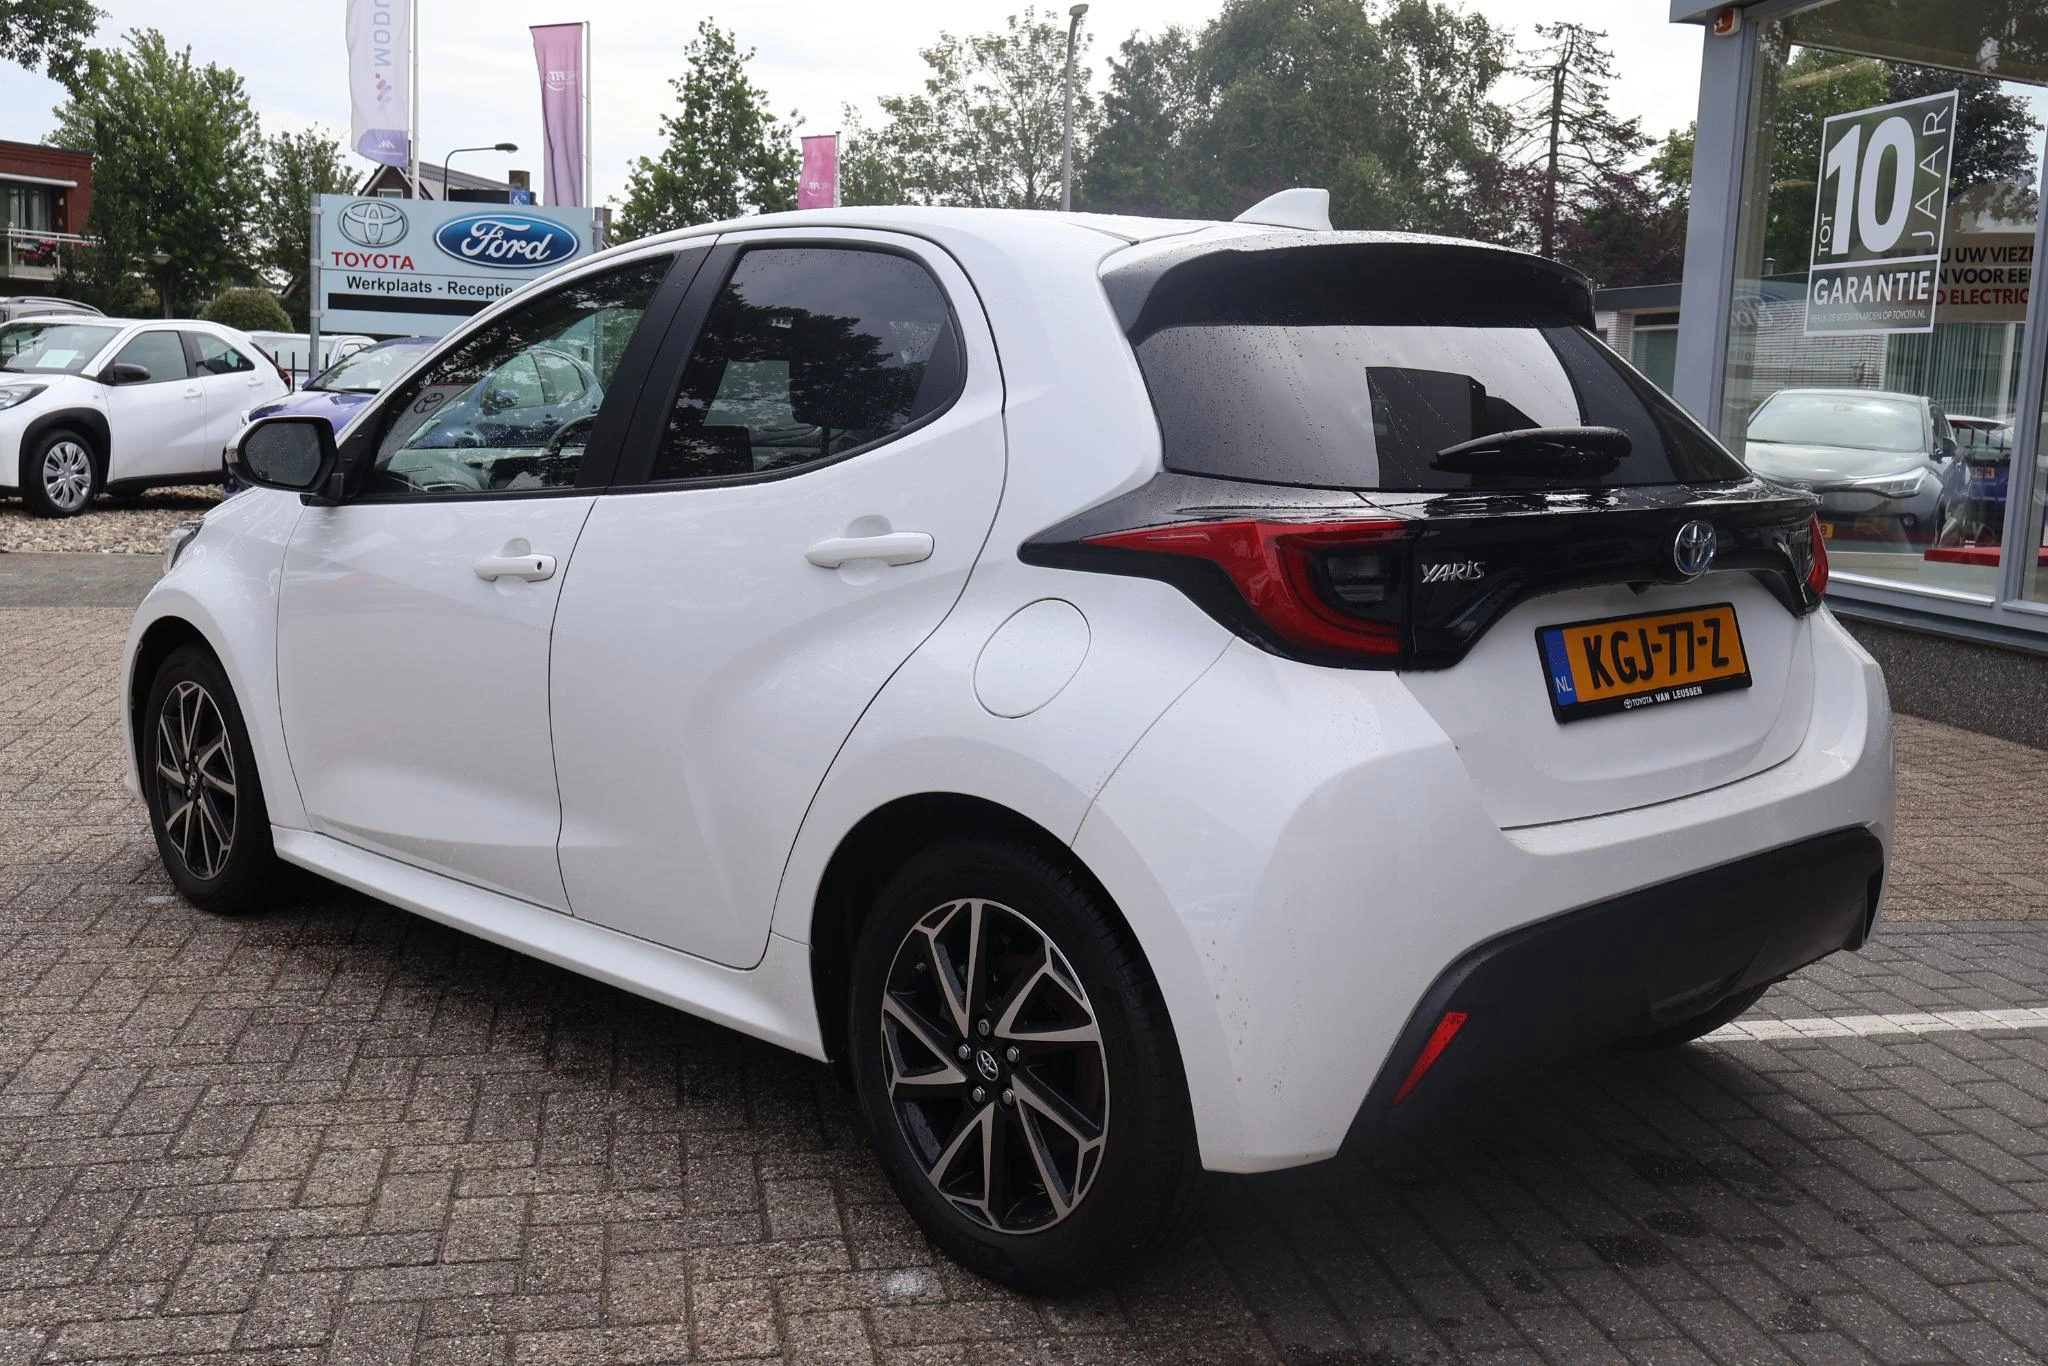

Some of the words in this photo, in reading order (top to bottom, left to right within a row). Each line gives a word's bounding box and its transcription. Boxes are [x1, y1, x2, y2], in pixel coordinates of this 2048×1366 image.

[1825, 116, 1916, 255] 10
[1911, 105, 1949, 247] JAAR
[460, 220, 552, 261] Ford
[1818, 212, 1832, 256] TOT
[331, 251, 415, 270] TOYOTA
[1955, 247, 1986, 263] UW
[1990, 246, 2033, 262] VIEZ
[347, 276, 432, 294] Werkplaats
[447, 281, 513, 298] Receptie
[1814, 270, 1931, 305] GARANTIE
[1952, 268, 2004, 284] VOOR
[2008, 268, 2031, 283] EE
[1583, 618, 1730, 690] KGJ-77-Z
[1555, 676, 1573, 693] NL
[1632, 695, 1653, 707] TOYOTA
[1655, 692, 1670, 703] VAN
[1672, 686, 1703, 700] LEUSSEN
